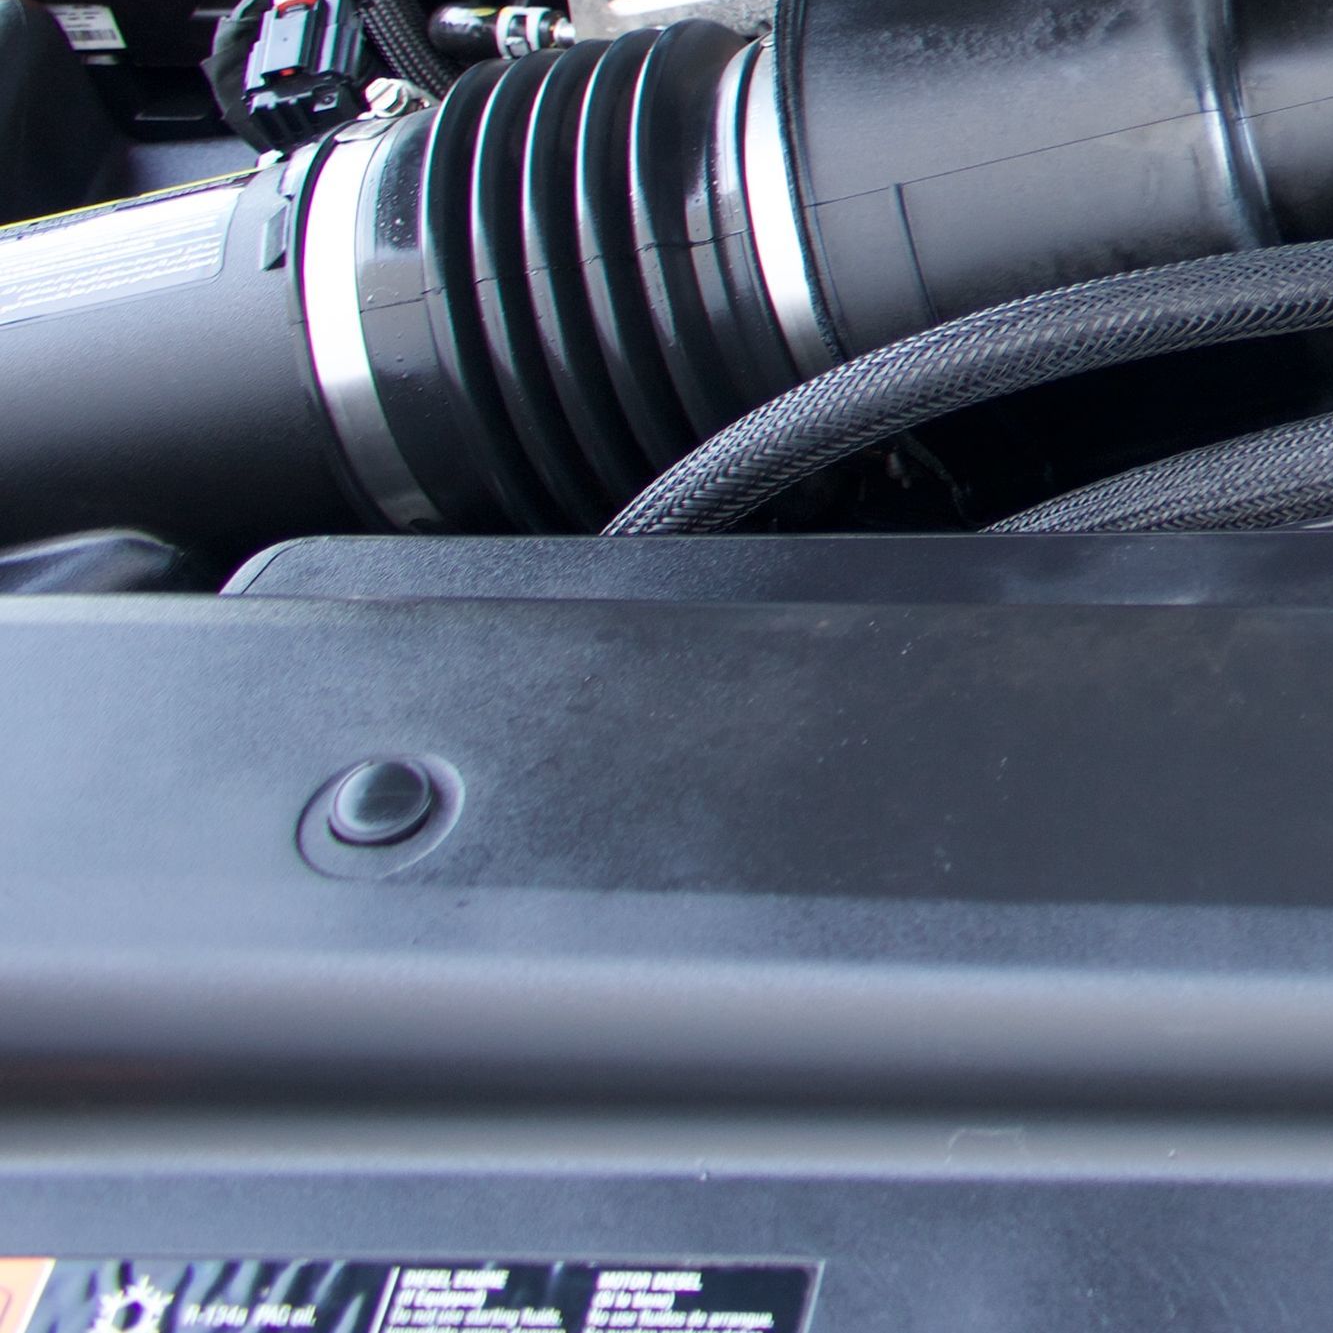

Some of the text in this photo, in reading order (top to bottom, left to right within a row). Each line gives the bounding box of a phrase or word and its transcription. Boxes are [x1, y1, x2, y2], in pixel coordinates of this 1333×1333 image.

[401, 1269, 510, 1290] DIESEL ENGINE
[597, 1271, 704, 1291] MOTOR DIESEL
[414, 1288, 488, 1309] Equipped)
[251, 1303, 292, 1327] PAG
[410, 1308, 438, 1326] not
[436, 1310, 465, 1326] use
[463, 1307, 521, 1329] starting
